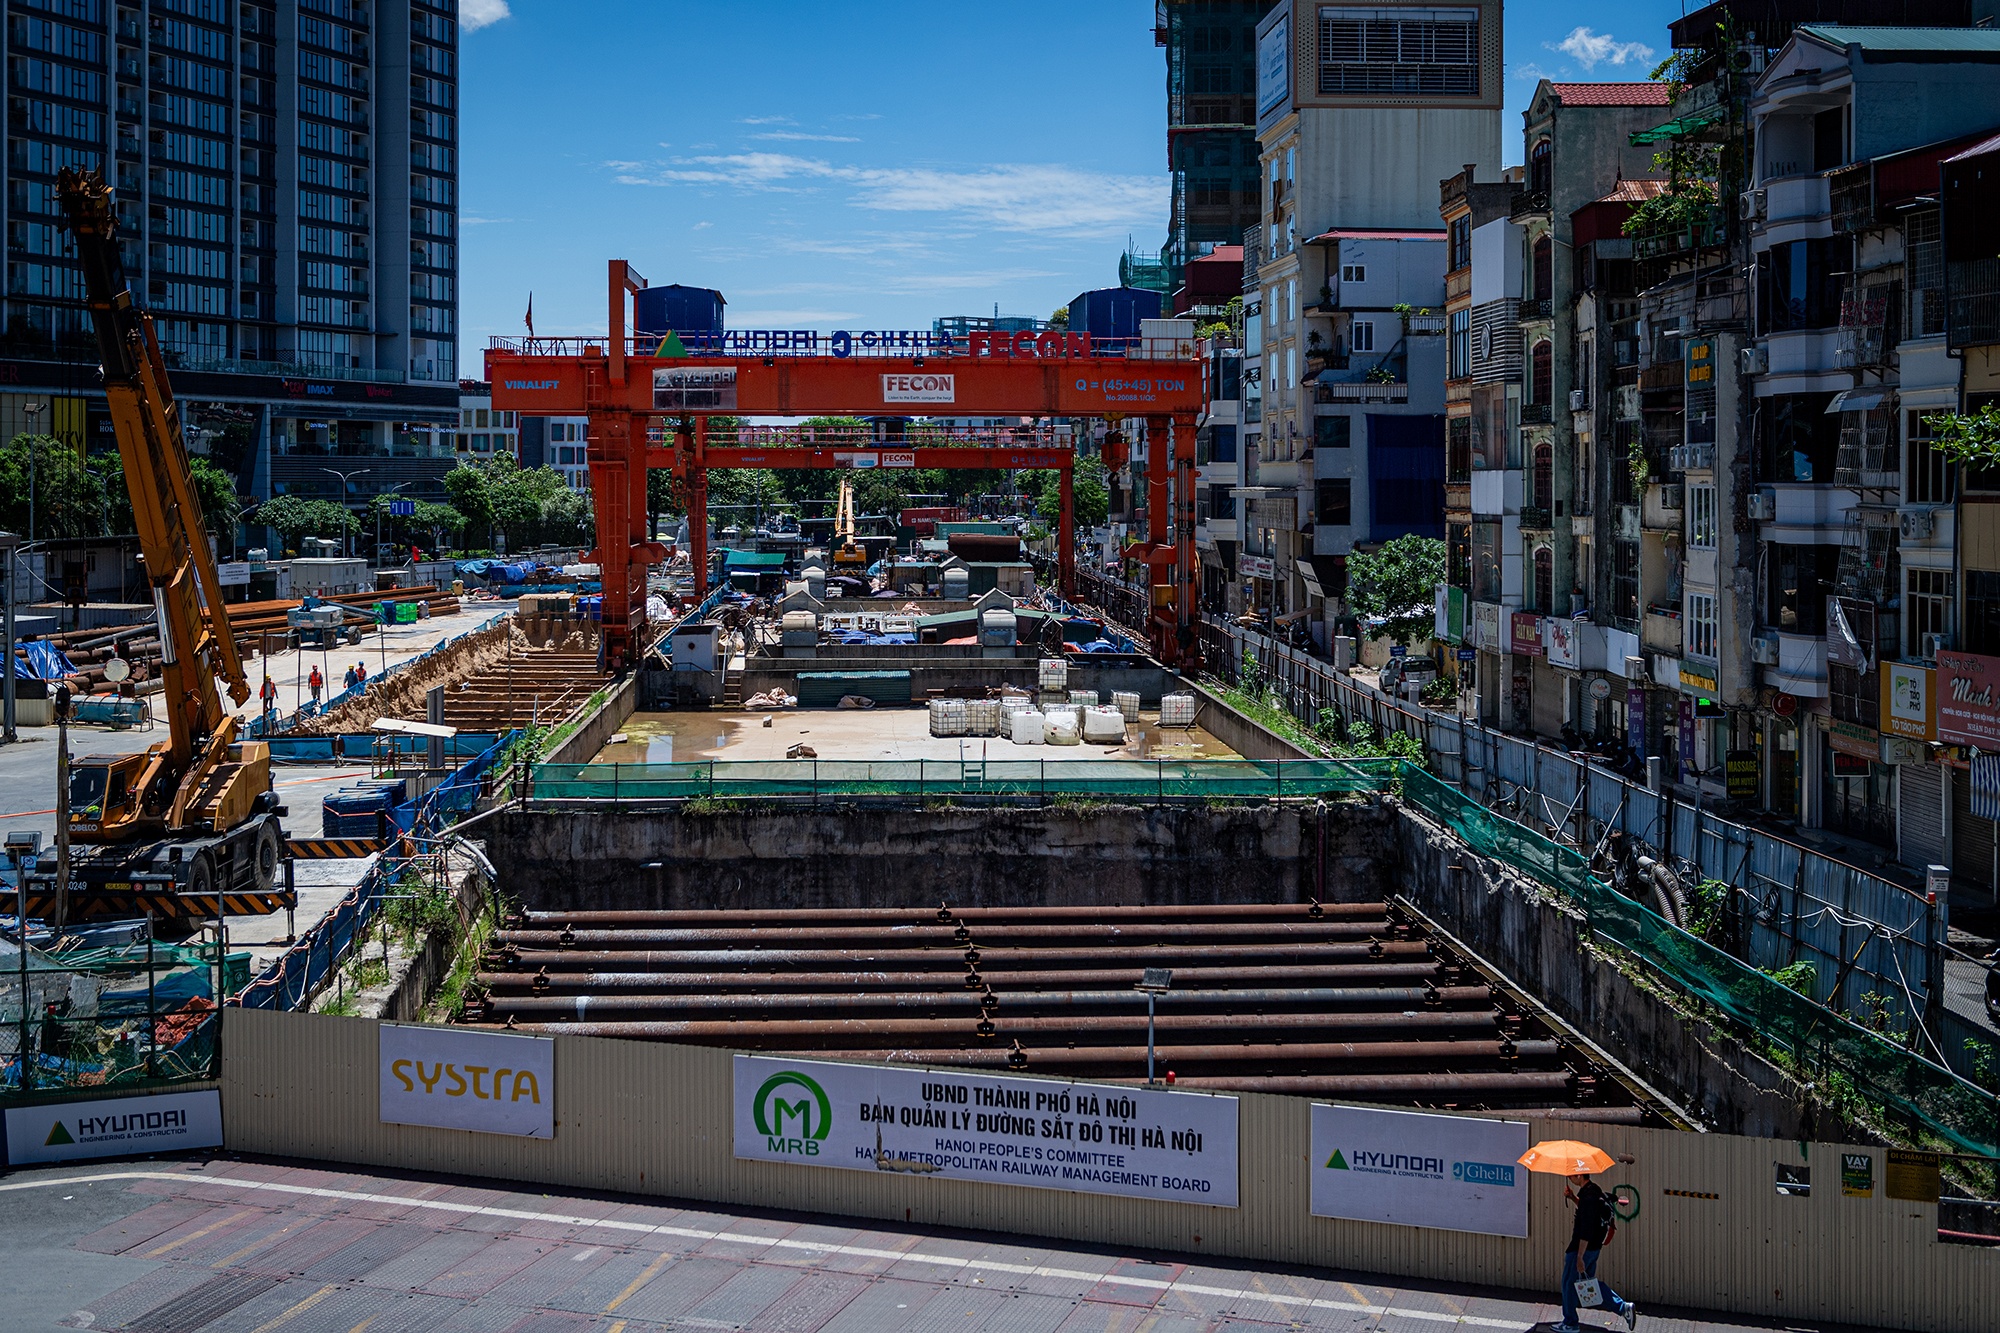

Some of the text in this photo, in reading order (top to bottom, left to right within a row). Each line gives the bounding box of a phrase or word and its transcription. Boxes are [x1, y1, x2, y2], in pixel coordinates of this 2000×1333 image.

[693, 330, 818, 349] HYUNDAI
[860, 330, 954, 347] GHELLA
[968, 330, 1092, 358] FECON
[307, 384, 334, 395] IMAX
[504, 380, 559, 390] VINALIFT
[887, 376, 951, 391] FECON
[1075, 379, 1087, 391] Q
[1102, 378, 1152, 393] (45+45)
[1155, 379, 1185, 391] TON
[1950, 676, 1992, 708] Minh
[1891, 717, 1900, 730] TÒ
[1727, 760, 1757, 773] MASSAGE
[391, 1059, 541, 1104] SYSTRA
[921, 1083, 1137, 1122] UBND THÀNH PHỐ HÀ NỘI
[78, 1109, 187, 1135] HYUNDAI
[900, 1103, 946, 1129] QUẢN
[951, 1108, 971, 1131] LÝ
[976, 1110, 1035, 1137] ĐƯỜNG
[1041, 1113, 1073, 1140] SẮT
[1078, 1119, 1103, 1143] ĐÔ
[1108, 1125, 1136, 1150] THỊ
[1141, 1126, 1166, 1149] HÀ
[1171, 1128, 1203, 1156] NỘI
[79, 1133, 126, 1143] ENGINEERING
[133, 1127, 187, 1139] CONSTRUCTION
[767, 1136, 820, 1156] MRB
[935, 1138, 1125, 1168] HANOI PEOPLE'S COMMITTEE
[1353, 1150, 1444, 1173] HYUNDAI
[1845, 1155, 1869, 1166] VAY
[1899, 1152, 1923, 1162] CHẬM
[1924, 1155, 1936, 1163] LẠI
[855, 1146, 895, 1160] HAOI
[1001, 1160, 1058, 1178] RAILWAY
[1062, 1167, 1158, 1187] MANAGEMENT
[1161, 1176, 1211, 1193] BOARD
[1353, 1166, 1392, 1175] ENGINEERING
[1398, 1171, 1444, 1180] CONSTRUCTION
[1466, 1164, 1513, 1182] Ghella
